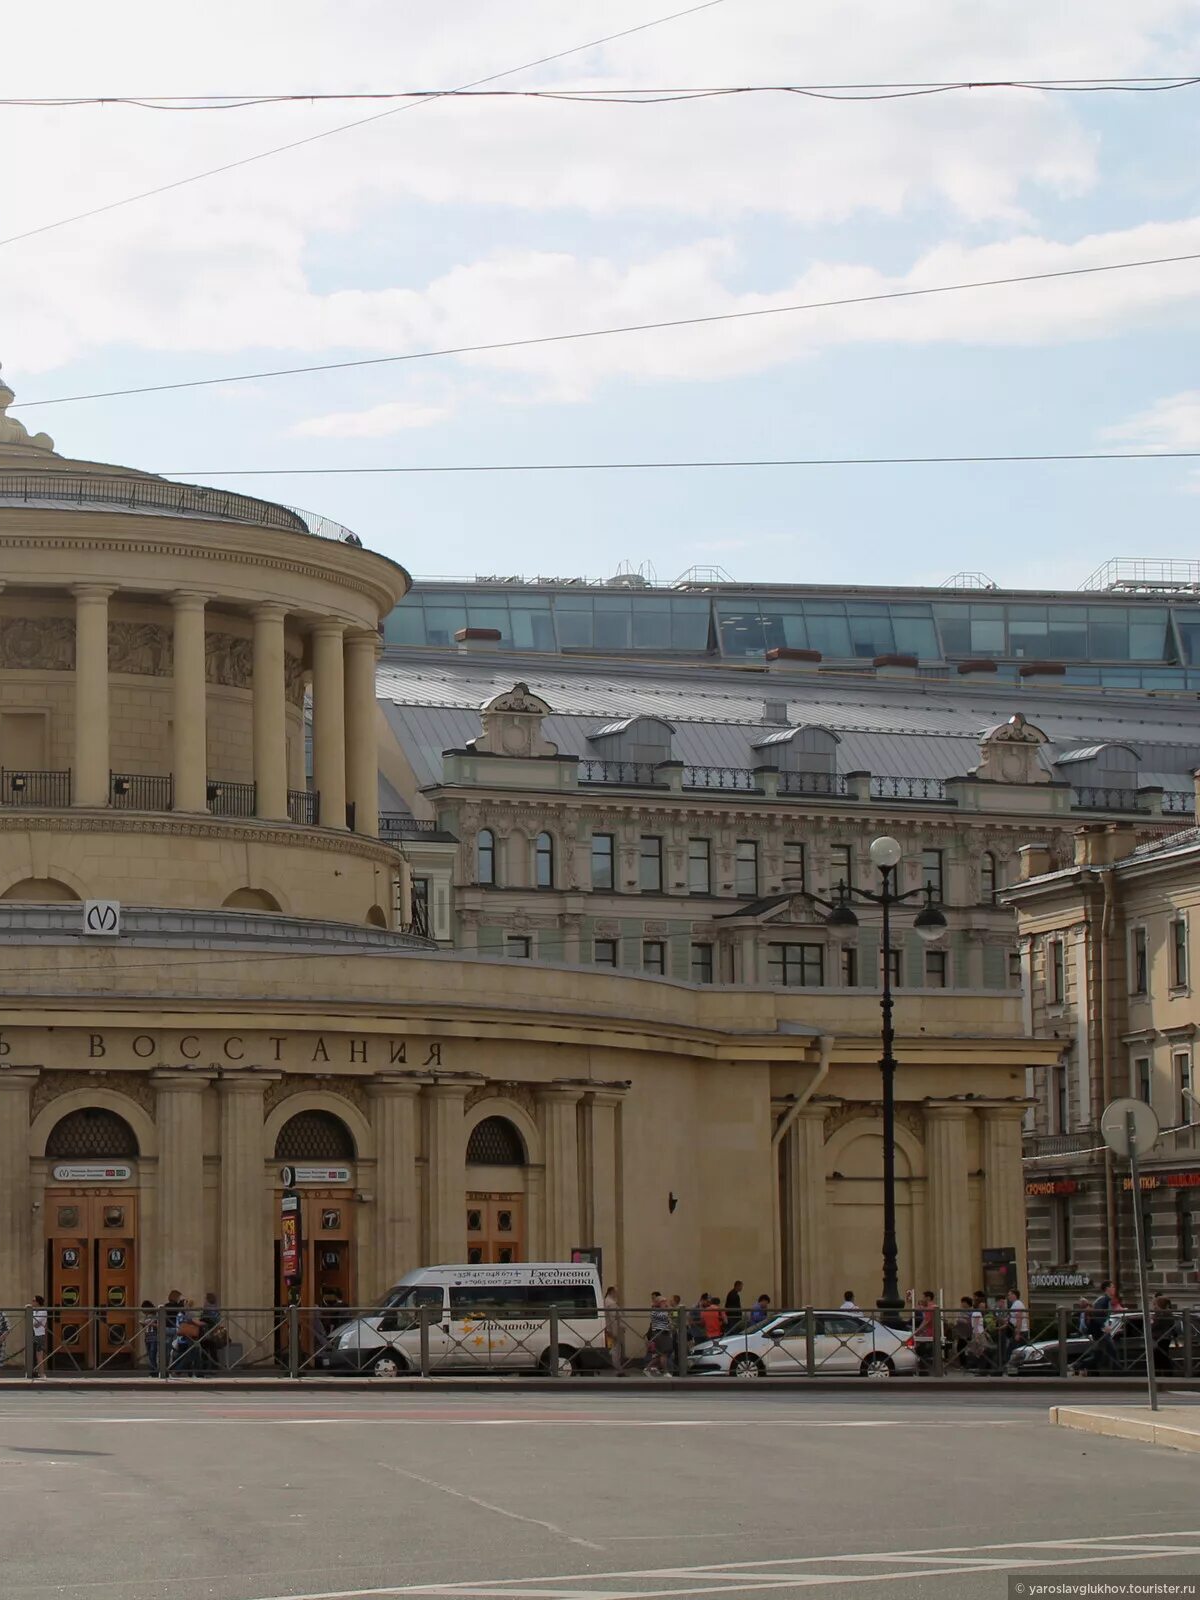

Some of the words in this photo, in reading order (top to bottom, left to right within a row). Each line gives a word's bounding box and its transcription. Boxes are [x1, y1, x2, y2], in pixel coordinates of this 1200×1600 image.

[88, 1034, 442, 1066] ВОССТАНИЯ
[530, 1268, 591, 1278] Ежедневно
[537, 1277, 594, 1285] Хельсинки
